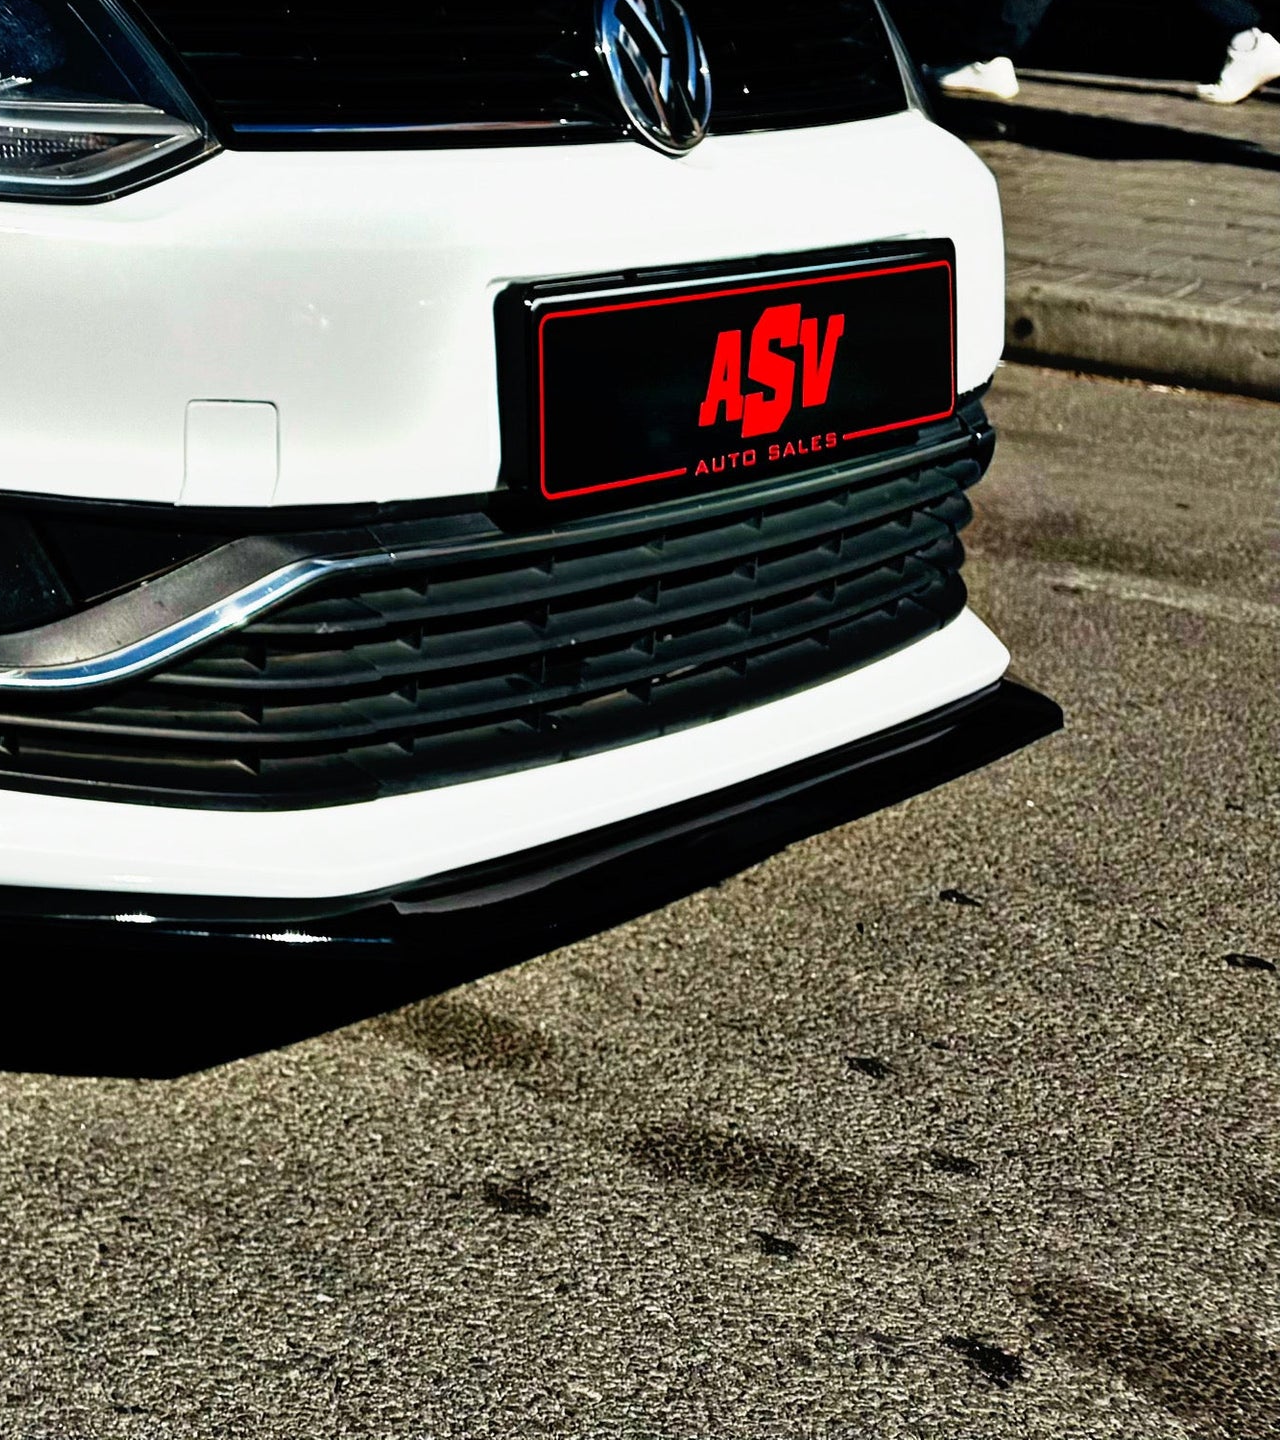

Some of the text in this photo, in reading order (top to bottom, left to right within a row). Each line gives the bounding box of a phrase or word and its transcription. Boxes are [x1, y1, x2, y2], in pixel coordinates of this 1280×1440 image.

[698, 302, 845, 439] ASV
[694, 432, 838, 476] AUTO SALES
